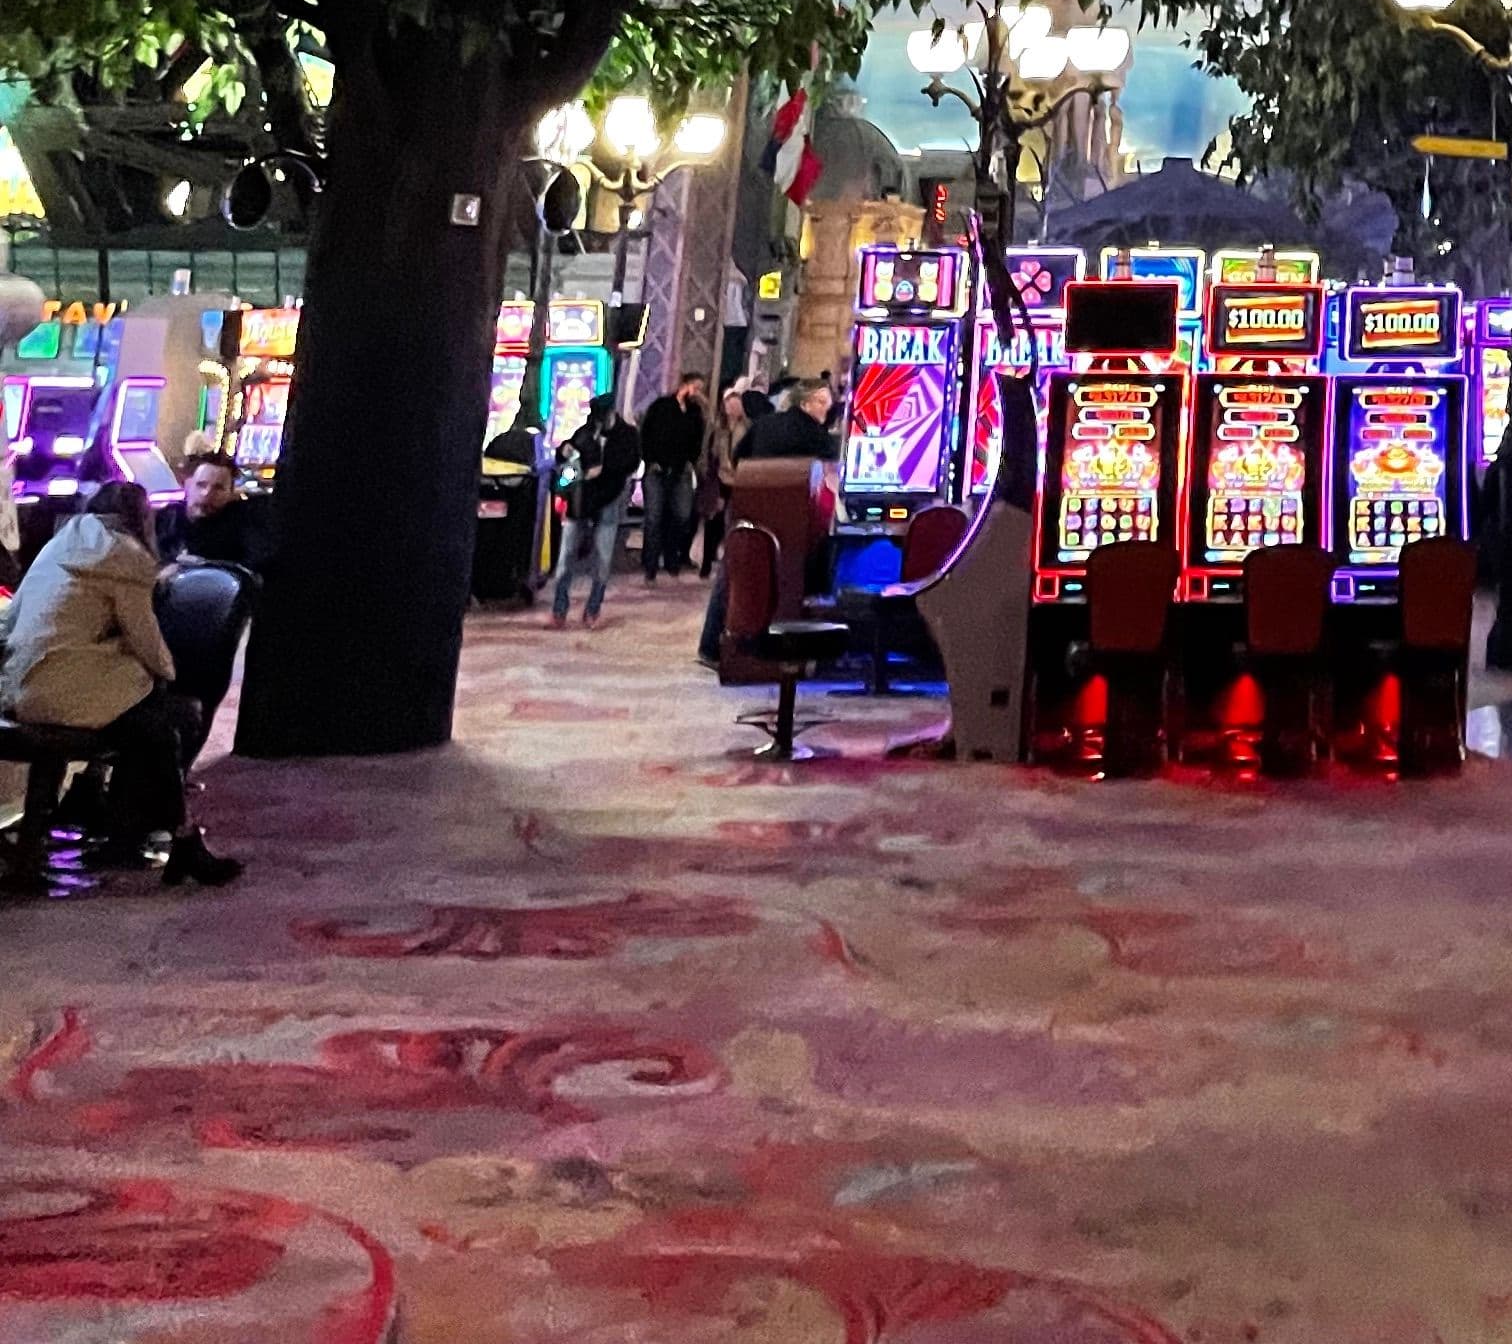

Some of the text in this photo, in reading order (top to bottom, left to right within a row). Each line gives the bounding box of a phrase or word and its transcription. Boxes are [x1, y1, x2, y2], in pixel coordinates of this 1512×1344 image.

[1228, 308, 1304, 329] $100.00
[1364, 312, 1439, 333] $100.00
[860, 327, 945, 365] BREAK
